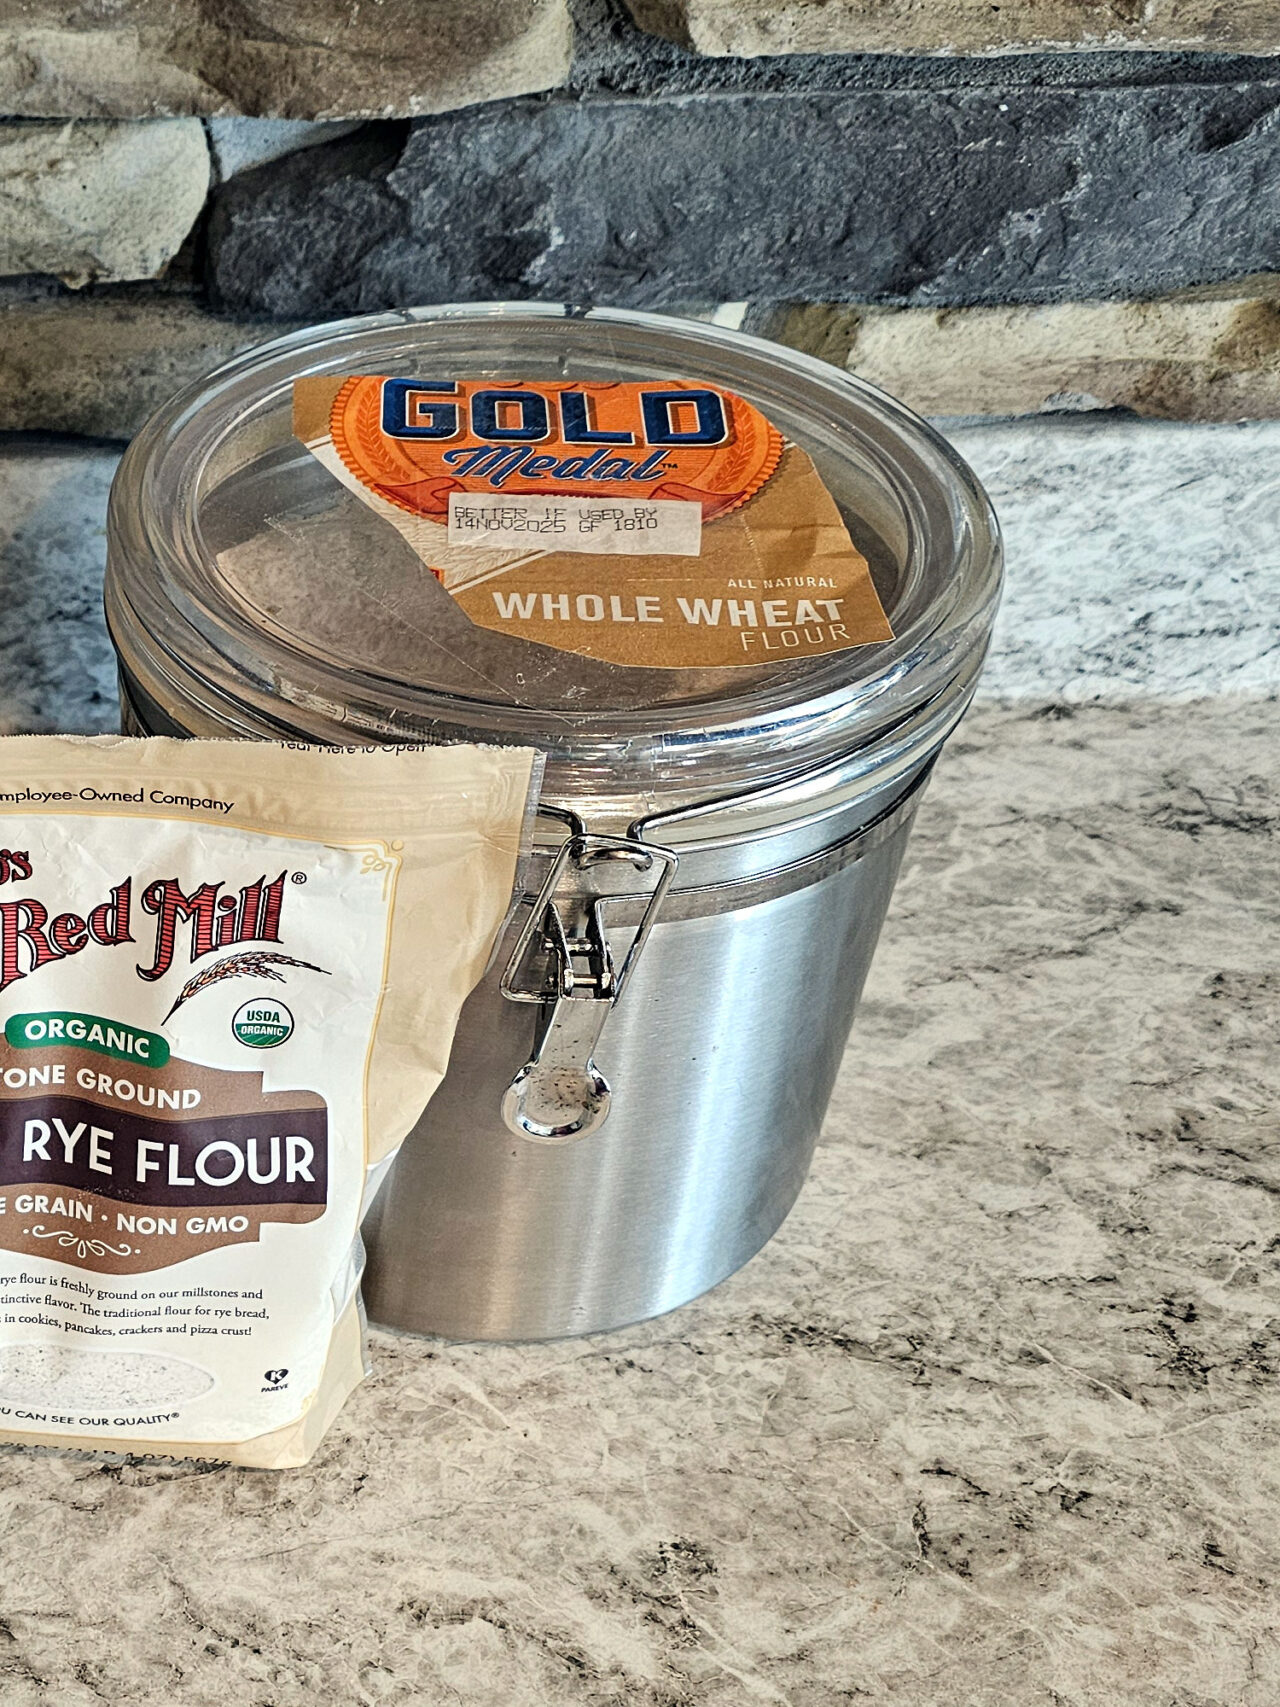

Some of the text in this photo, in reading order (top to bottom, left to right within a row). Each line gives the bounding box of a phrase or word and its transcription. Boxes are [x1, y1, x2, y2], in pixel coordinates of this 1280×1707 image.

[381, 377, 730, 446] GOLD
[454, 506, 658, 521] BETTER IF USED BY
[456, 518, 658, 533] 14NOV2025 GF 1810
[727, 576, 838, 589] ALL NATURAL
[492, 591, 845, 627] WHOLE WHEAT
[740, 623, 851, 651] FLOUR
[149, 790, 235, 814] Company
[246, 1010, 280, 1023] USDA
[24, 1018, 150, 1059] ORGANIC
[240, 1025, 284, 1037] ORGANIC
[76, 1068, 202, 1109] GROUND
[22, 1118, 114, 1175] RYE
[136, 1136, 316, 1187] FLOUR
[14, 1194, 93, 1223] GRAIN
[117, 1213, 176, 1235] NON
[186, 1215, 249, 1234] GMO
[0, 1276, 17, 1288] rye
[20, 1273, 47, 1285] flour
[49, 1276, 58, 1286] is
[60, 1277, 95, 1297] freshly
[97, 1290, 138, 1301] ground
[182, 1287, 239, 1298] millstones
[241, 1289, 263, 1299] and
[44, 1294, 78, 1312] flavor.
[80, 1302, 101, 1317] The
[103, 1306, 161, 1318] traditional
[164, 1305, 192, 1316] flour
[195, 1305, 211, 1316] for
[214, 1309, 232, 1319] rye
[235, 1307, 270, 1320] bread,
[4, 1314, 16, 1323] in
[18, 1313, 62, 1328] cookies,
[64, 1321, 116, 1337] pancakes,
[118, 1325, 163, 1335] crackers
[166, 1323, 187, 1333] and
[190, 1325, 219, 1336] pizza
[221, 1326, 252, 1336] crust!
[14, 1410, 46, 1421] CAN
[51, 1415, 75, 1424] SEE
[79, 1417, 109, 1426] OUR
